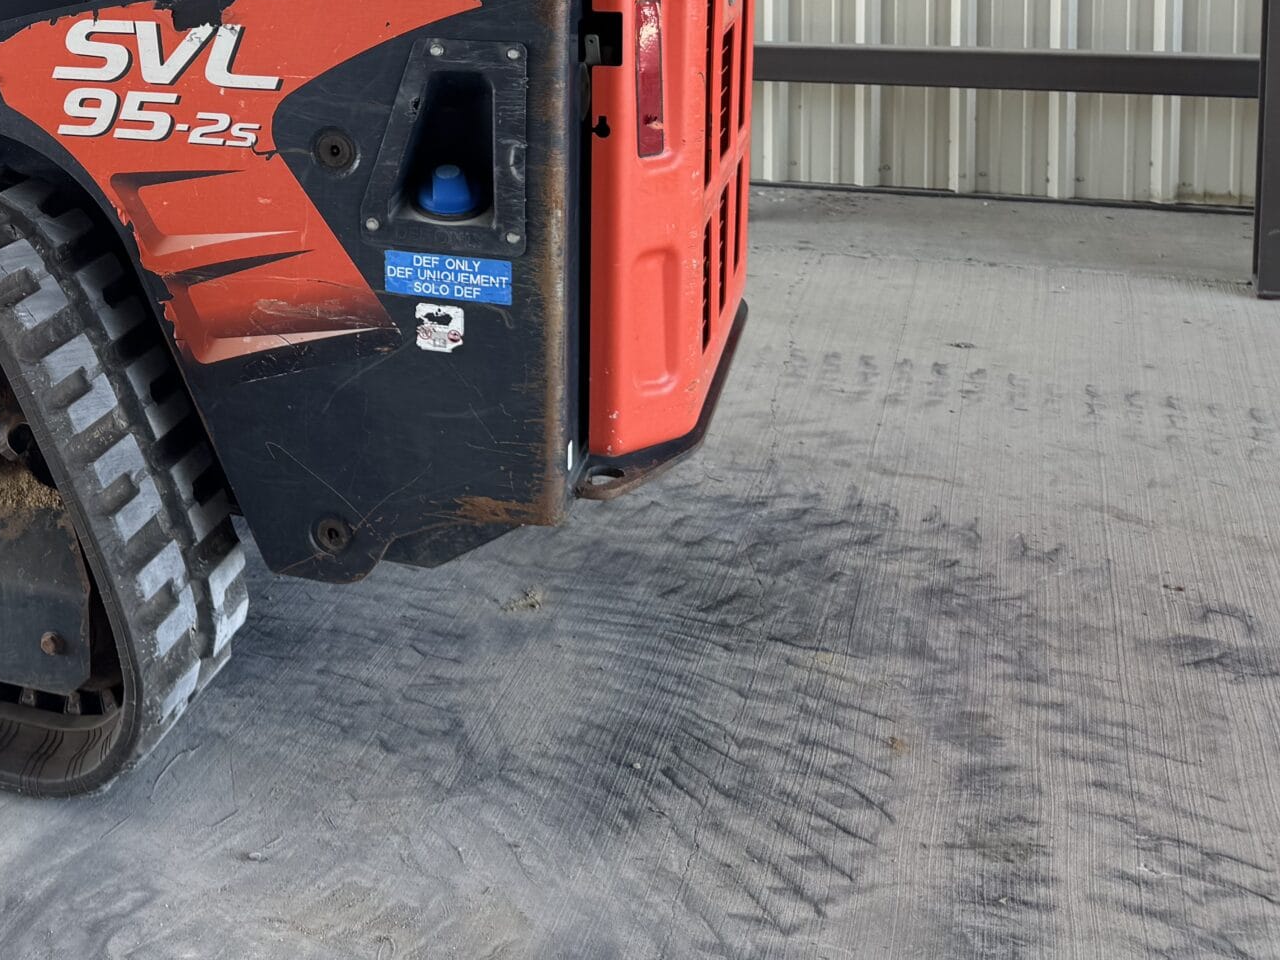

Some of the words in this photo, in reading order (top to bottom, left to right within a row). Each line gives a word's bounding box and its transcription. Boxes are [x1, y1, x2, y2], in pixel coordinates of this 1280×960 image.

[52, 18, 282, 91] SVL
[413, 255, 440, 268] DEF
[445, 258, 481, 272] ONLY
[387, 265, 413, 278] DEF
[418, 269, 509, 289] UNIQUEMENT
[414, 282, 450, 296] SOLO
[454, 285, 482, 298] DEF
